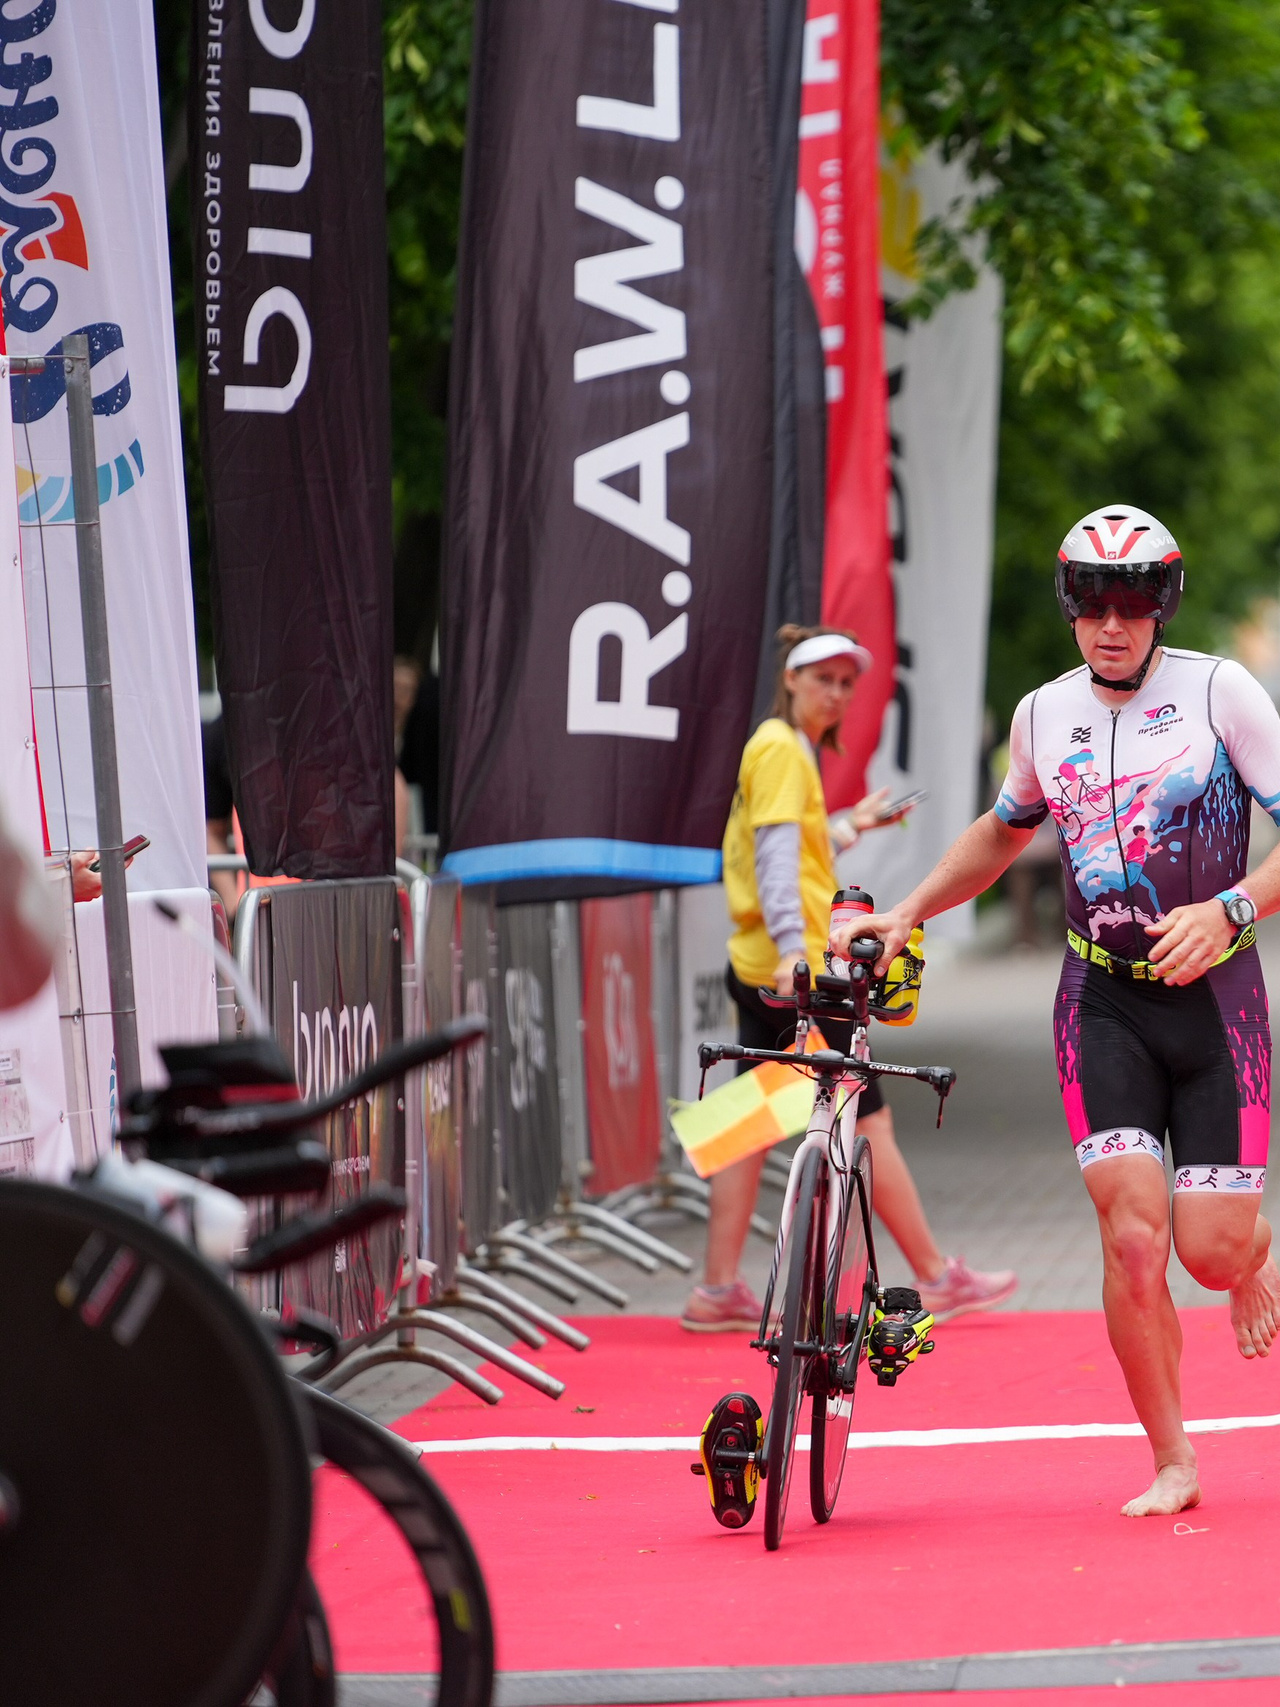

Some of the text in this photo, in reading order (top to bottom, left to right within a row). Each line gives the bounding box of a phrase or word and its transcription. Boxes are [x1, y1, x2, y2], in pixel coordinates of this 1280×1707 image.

[203, 151, 223, 376] ЗДОРОВЬЕМ
[822, 157, 844, 300] ЖУРНАЛ
[567, 0, 692, 742] R.A.W.L
[1138, 716, 1184, 736] Преодолей
